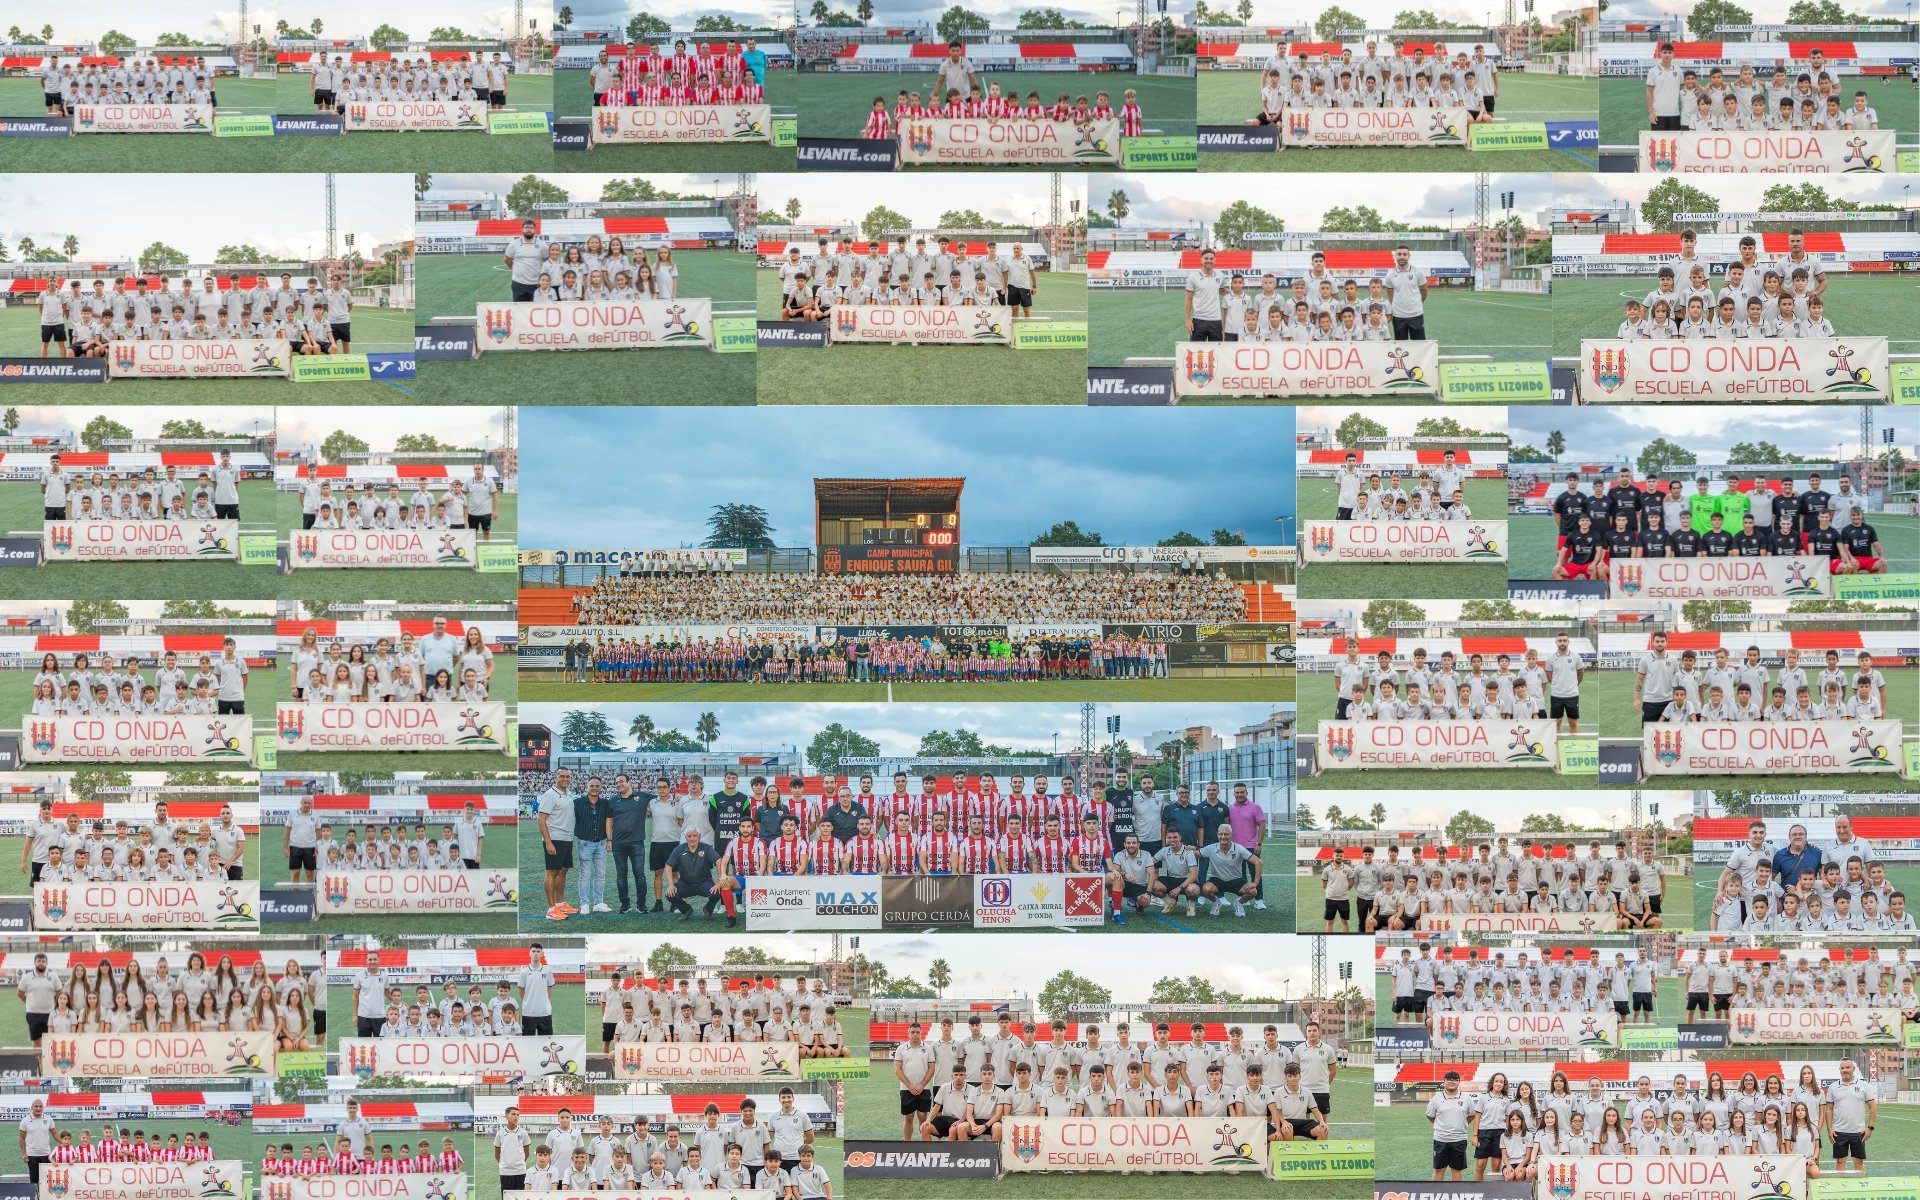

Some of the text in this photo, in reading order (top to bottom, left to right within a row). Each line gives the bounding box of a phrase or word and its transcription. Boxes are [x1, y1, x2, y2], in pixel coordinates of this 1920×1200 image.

[105, 108, 173, 120] CD ONDA
[377, 105, 446, 116] CD ONDA
[632, 110, 720, 125] CD ONDA
[1324, 112, 1414, 128] CD ONDA
[949, 124, 1056, 143] CD ONDA
[1476, 135, 1542, 145] ESPORTS LIZONDO
[940, 147, 994, 157] ESCUELA
[1697, 137, 1822, 159] CD ONDA
[530, 306, 645, 328] CD ONDA
[871, 309, 959, 326] CD ONDA
[862, 329, 907, 339] ESCUELA
[1020, 335, 1053, 343] ESPORTS
[149, 344, 237, 361] CD ONDA
[1235, 348, 1364, 371] CD ONDA
[1650, 346, 1800, 373] CD ONDA
[140, 364, 186, 373] ESCUELA
[1222, 376, 1288, 390] ESCUELA
[1449, 381, 1543, 393] ESPORTS LIZONDO
[1635, 381, 1712, 395] ESCUELA
[88, 525, 183, 541] CD ONDA
[1350, 526, 1450, 542] CD ONDA
[332, 535, 422, 550] CD ONDA
[574, 551, 643, 564] macer
[867, 549, 934, 557] CAMP MUNICIPAL
[1103, 548, 1125, 562] crg
[847, 560, 954, 571] ENRIQUE SAURA GIL
[1659, 562, 1767, 582] CD ONDA
[1141, 626, 1182, 637] ATRIO
[322, 709, 438, 728] CD ONDA
[74, 721, 186, 740] CD ONDA
[1372, 726, 1488, 746] CD ONDA
[311, 735, 371, 745] ESCUELA
[1702, 728, 1828, 749] CD ONDA
[63, 746, 120, 756] ESCUELA
[1690, 757, 1754, 768] ESCUELA
[365, 875, 469, 893] CD ONDA
[86, 888, 198, 907] CD ONDA
[355, 899, 408, 908] ESCUELA
[776, 896, 803, 905] Onda
[816, 892, 878, 904] MAX
[1067, 879, 1101, 914] EL MOLINO
[1067, 906, 1077, 914] EL
[1075, 879, 1101, 906] MOLINO
[817, 906, 878, 914] COLCHON
[885, 909, 970, 921] GRUPO CERDÁ
[75, 913, 132, 923] ESCUELA
[1474, 1016, 1564, 1032] CD ONDA
[1768, 1013, 1852, 1027] CD ONDA
[94, 1039, 207, 1059] CD ONDA
[396, 1043, 519, 1064] CD ONDA
[656, 1048, 746, 1062] CD ONDA
[1061, 1124, 1190, 1147] CD ONDA
[1048, 1152, 1114, 1165] ESCUELA
[1281, 1160, 1327, 1172] ESPORTS
[84, 1168, 185, 1184] CD ONDA
[1597, 1162, 1728, 1185] CD ONDA
[308, 1179, 409, 1197] CD ONDA
